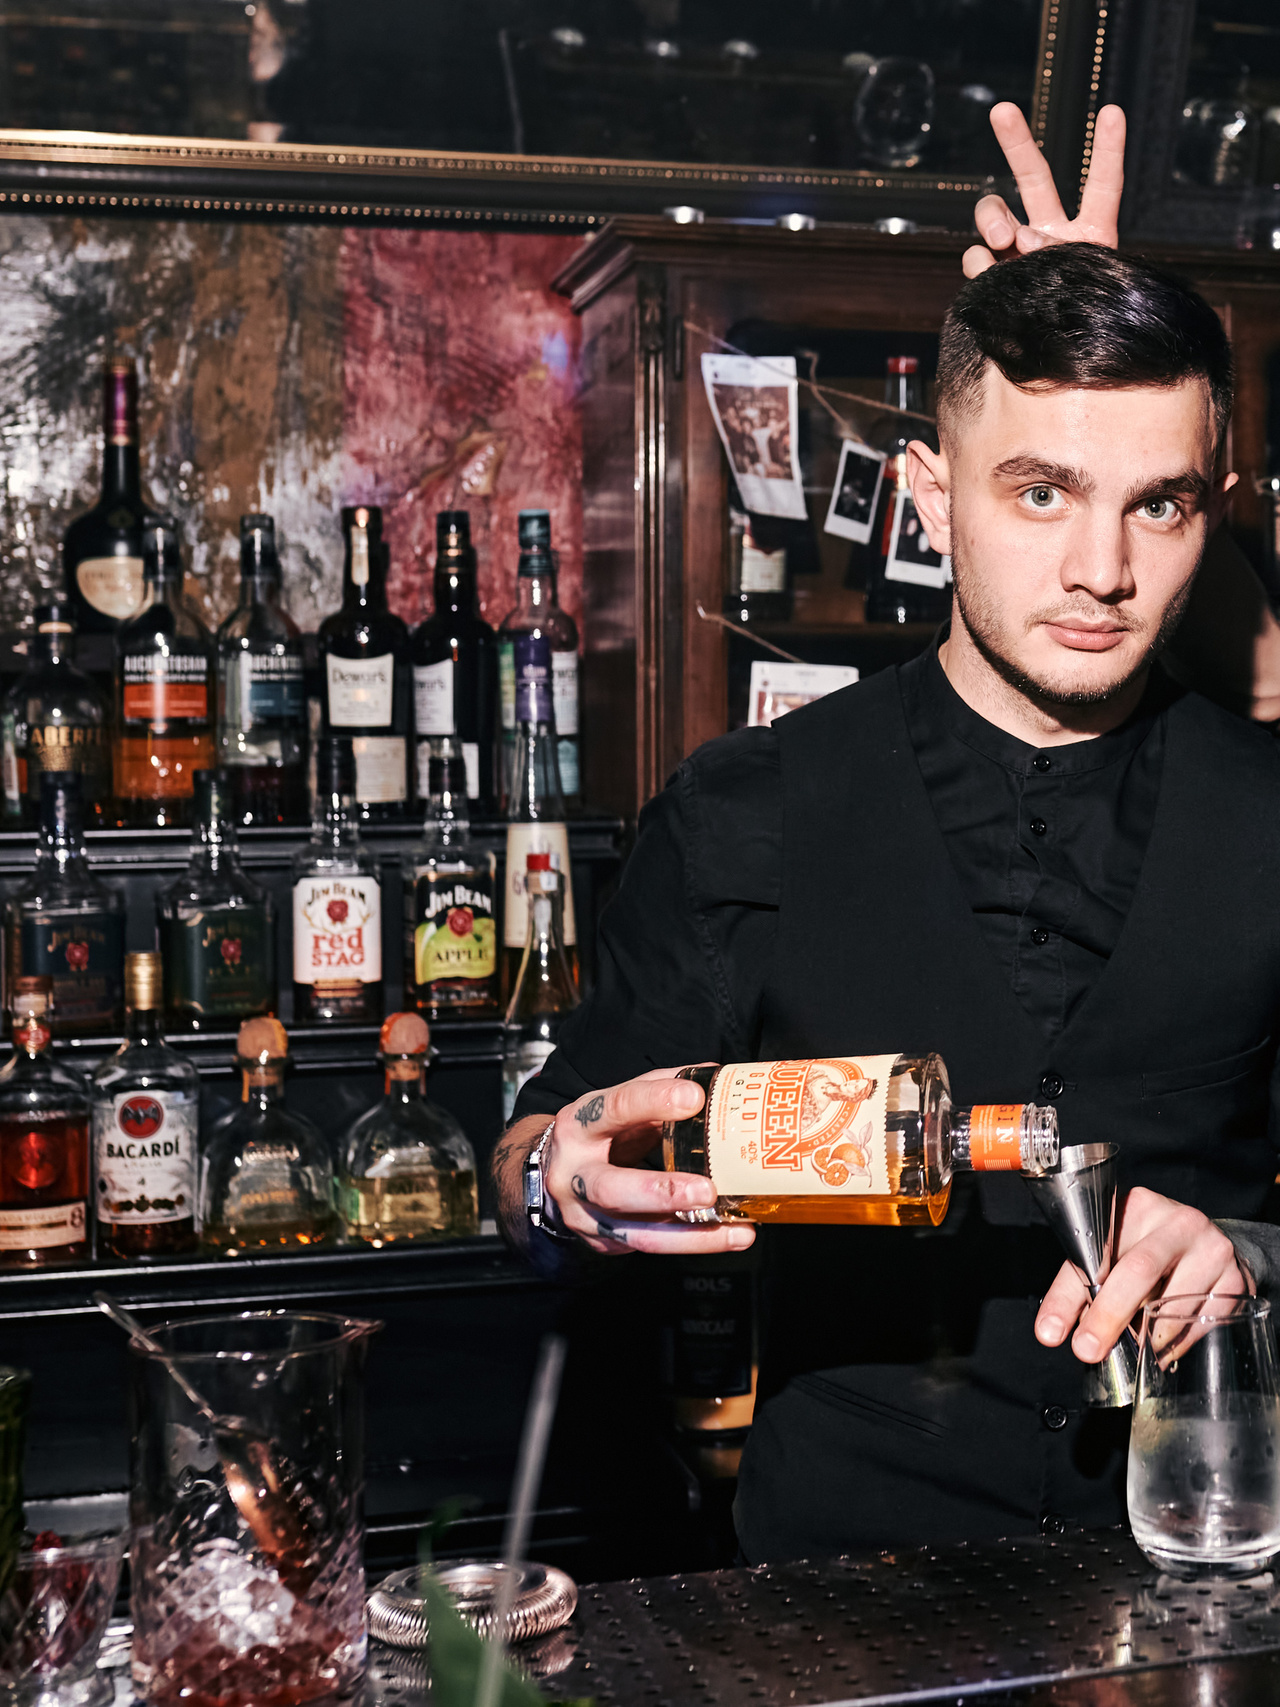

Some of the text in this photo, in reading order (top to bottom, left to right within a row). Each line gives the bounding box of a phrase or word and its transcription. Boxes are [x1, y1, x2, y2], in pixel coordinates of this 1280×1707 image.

[307, 883, 366, 906] JIM BEAM
[425, 885, 492, 918] JIM BEAM
[312, 927, 364, 950] red
[312, 951, 365, 967] STAG
[433, 948, 489, 964] APPLE
[742, 1072, 766, 1121] GOLD
[812, 1110, 850, 1147] CRAFTED
[996, 1105, 1016, 1145] GIN
[106, 1135, 180, 1159] BACARDÍ
[748, 1140, 758, 1164] 40%
[70, 1206, 83, 1229] 8
